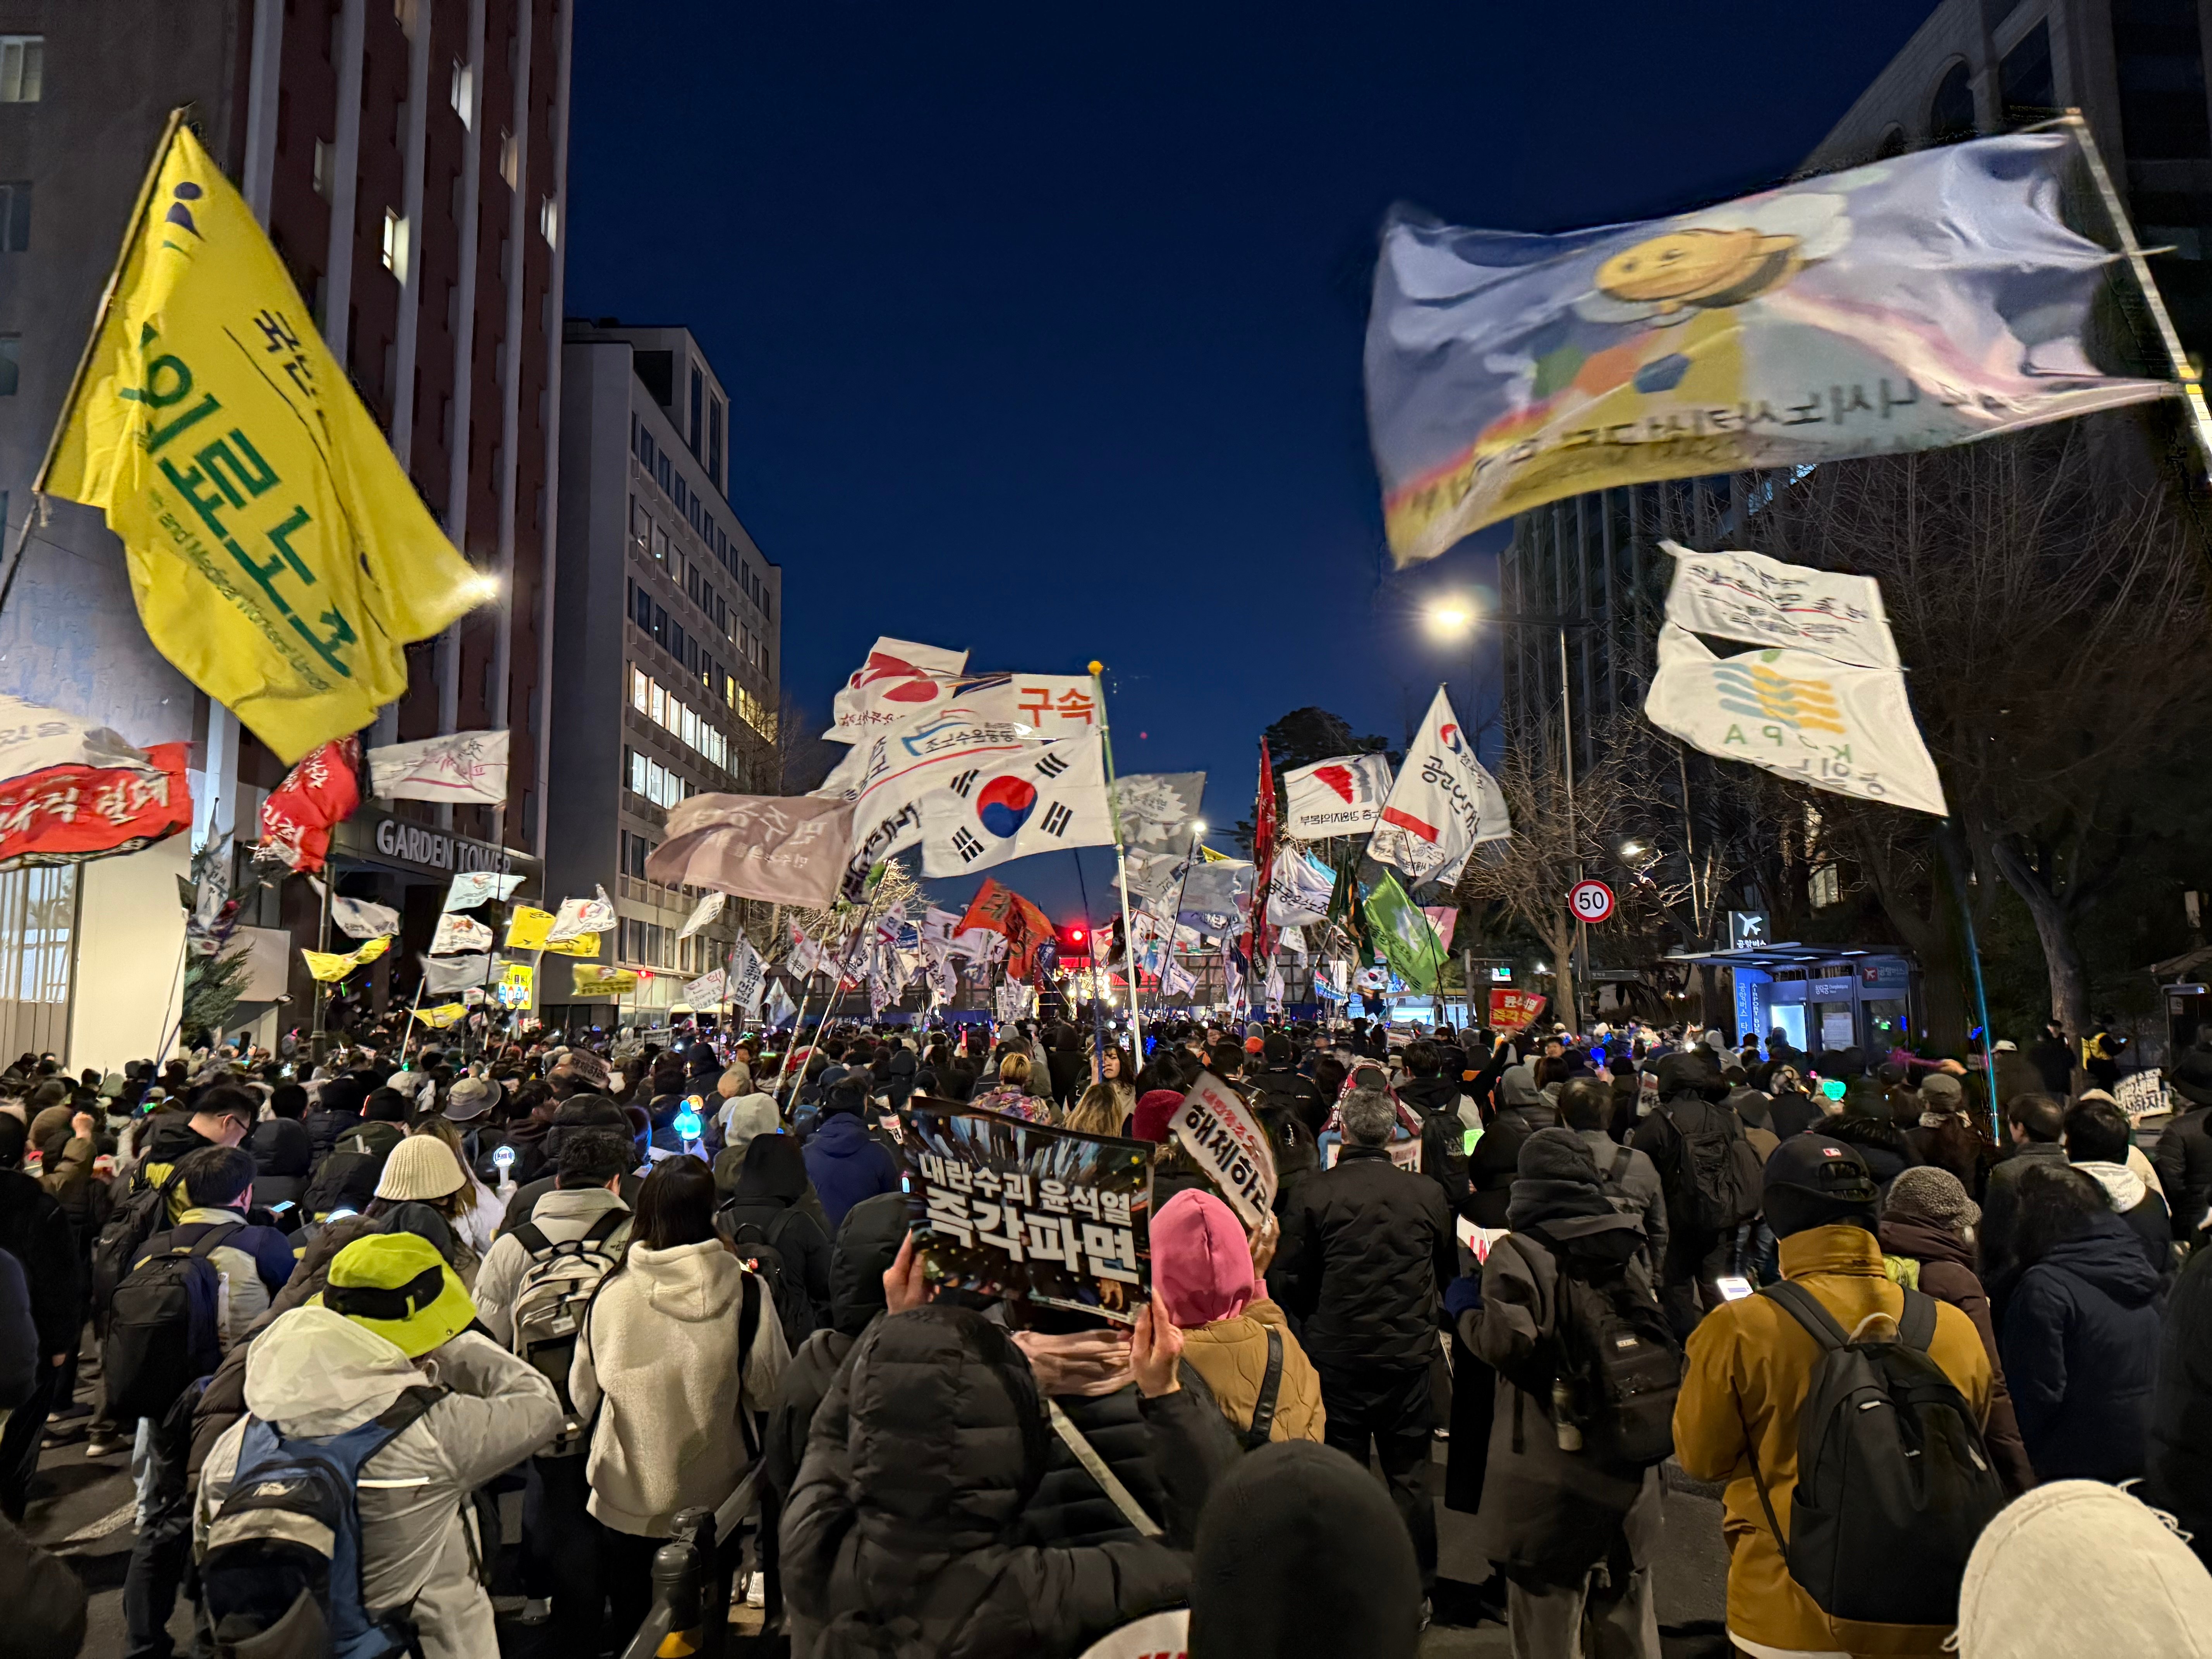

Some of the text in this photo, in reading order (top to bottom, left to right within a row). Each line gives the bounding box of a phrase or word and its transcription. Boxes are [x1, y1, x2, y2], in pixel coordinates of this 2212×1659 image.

[120, 321, 358, 678] 의료노조
[1018, 687, 1095, 727] 구속
[377, 819, 512, 874] GARDEN TOWER
[1579, 891, 1604, 910] 50
[1737, 939, 1766, 949] 공항버스
[1739, 982, 1748, 1017] 공항버스
[919, 1154, 1132, 1227] 내란수괴 윤석열
